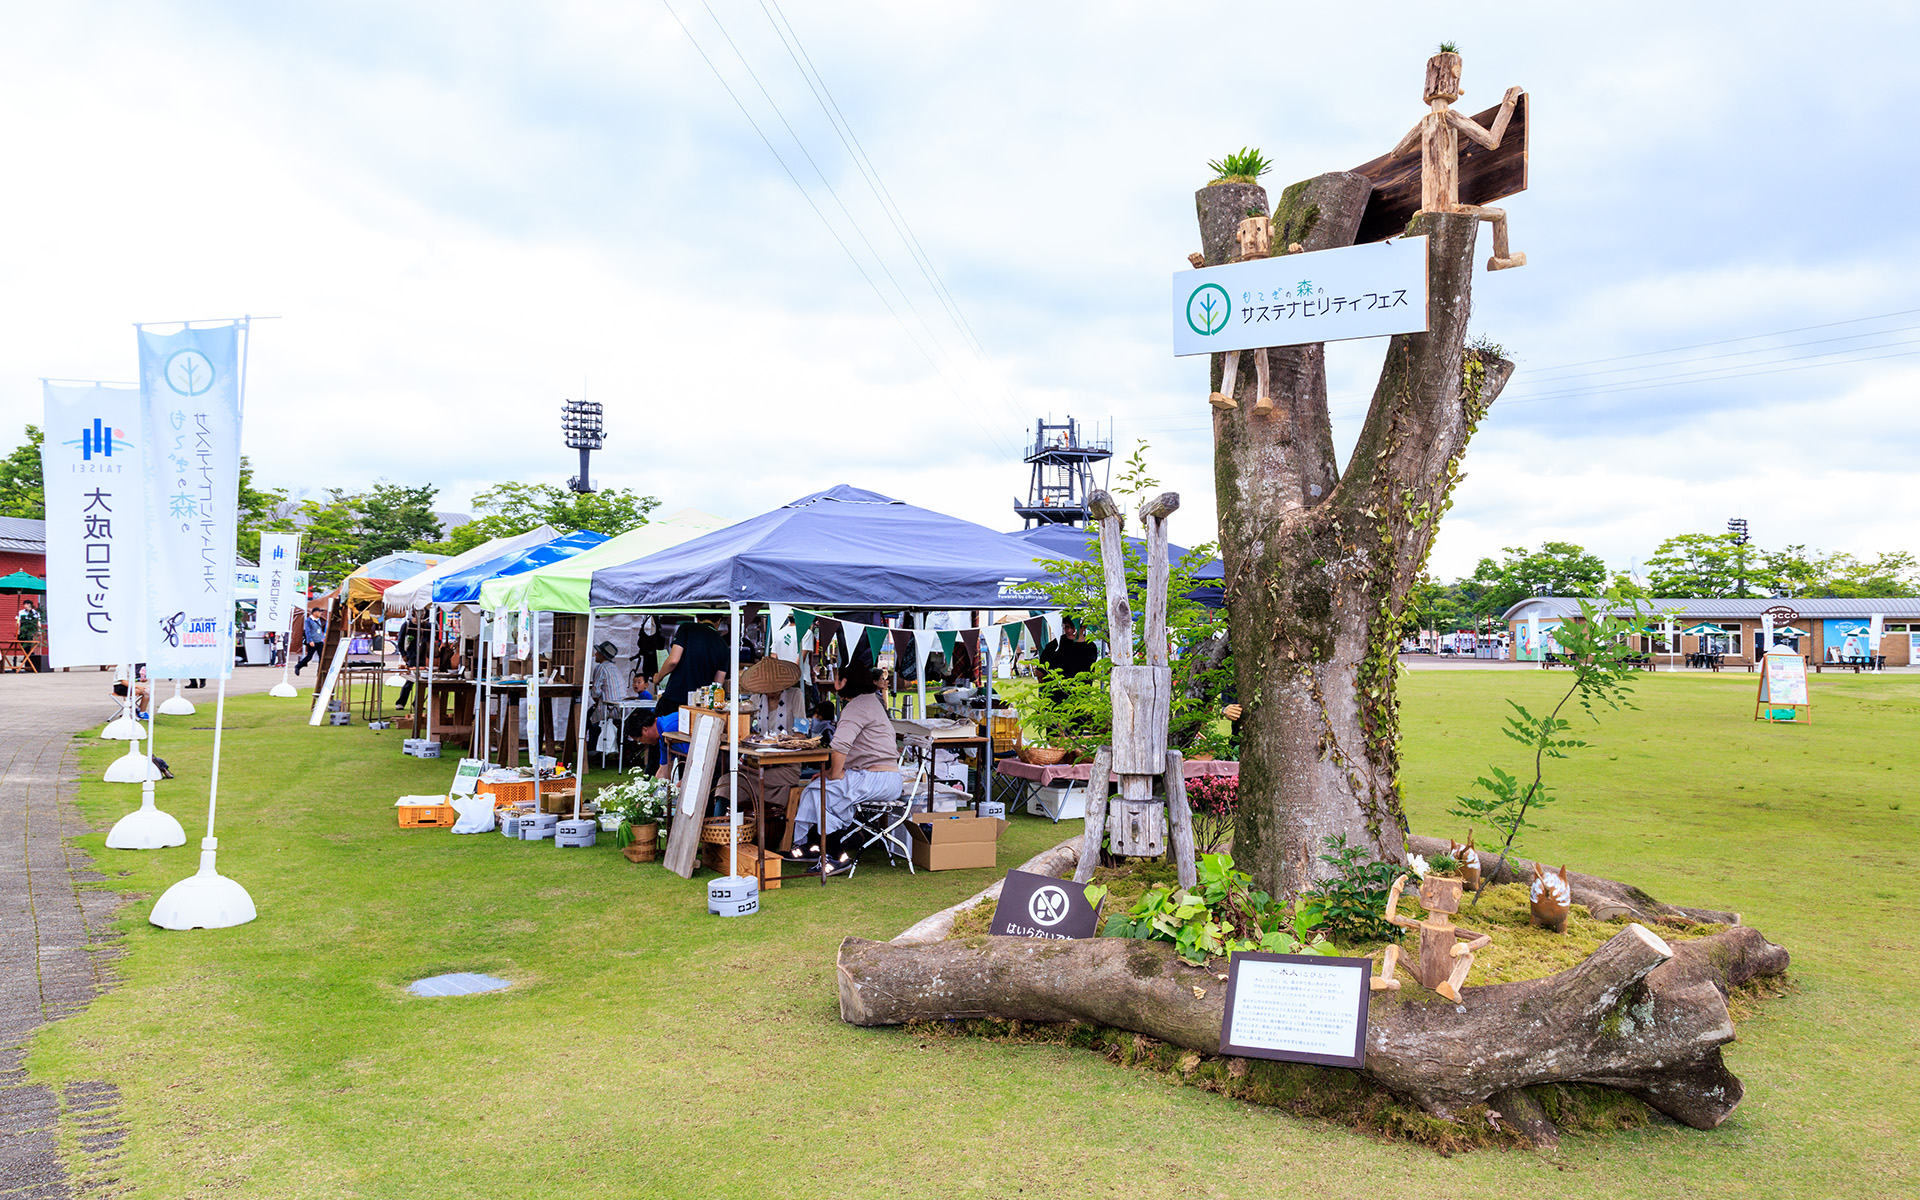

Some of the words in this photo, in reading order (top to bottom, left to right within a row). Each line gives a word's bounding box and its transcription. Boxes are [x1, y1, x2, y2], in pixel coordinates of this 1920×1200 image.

[1241, 289, 1408, 324] サステナビリティフェス
[236, 573, 259, 583] FICIAL
